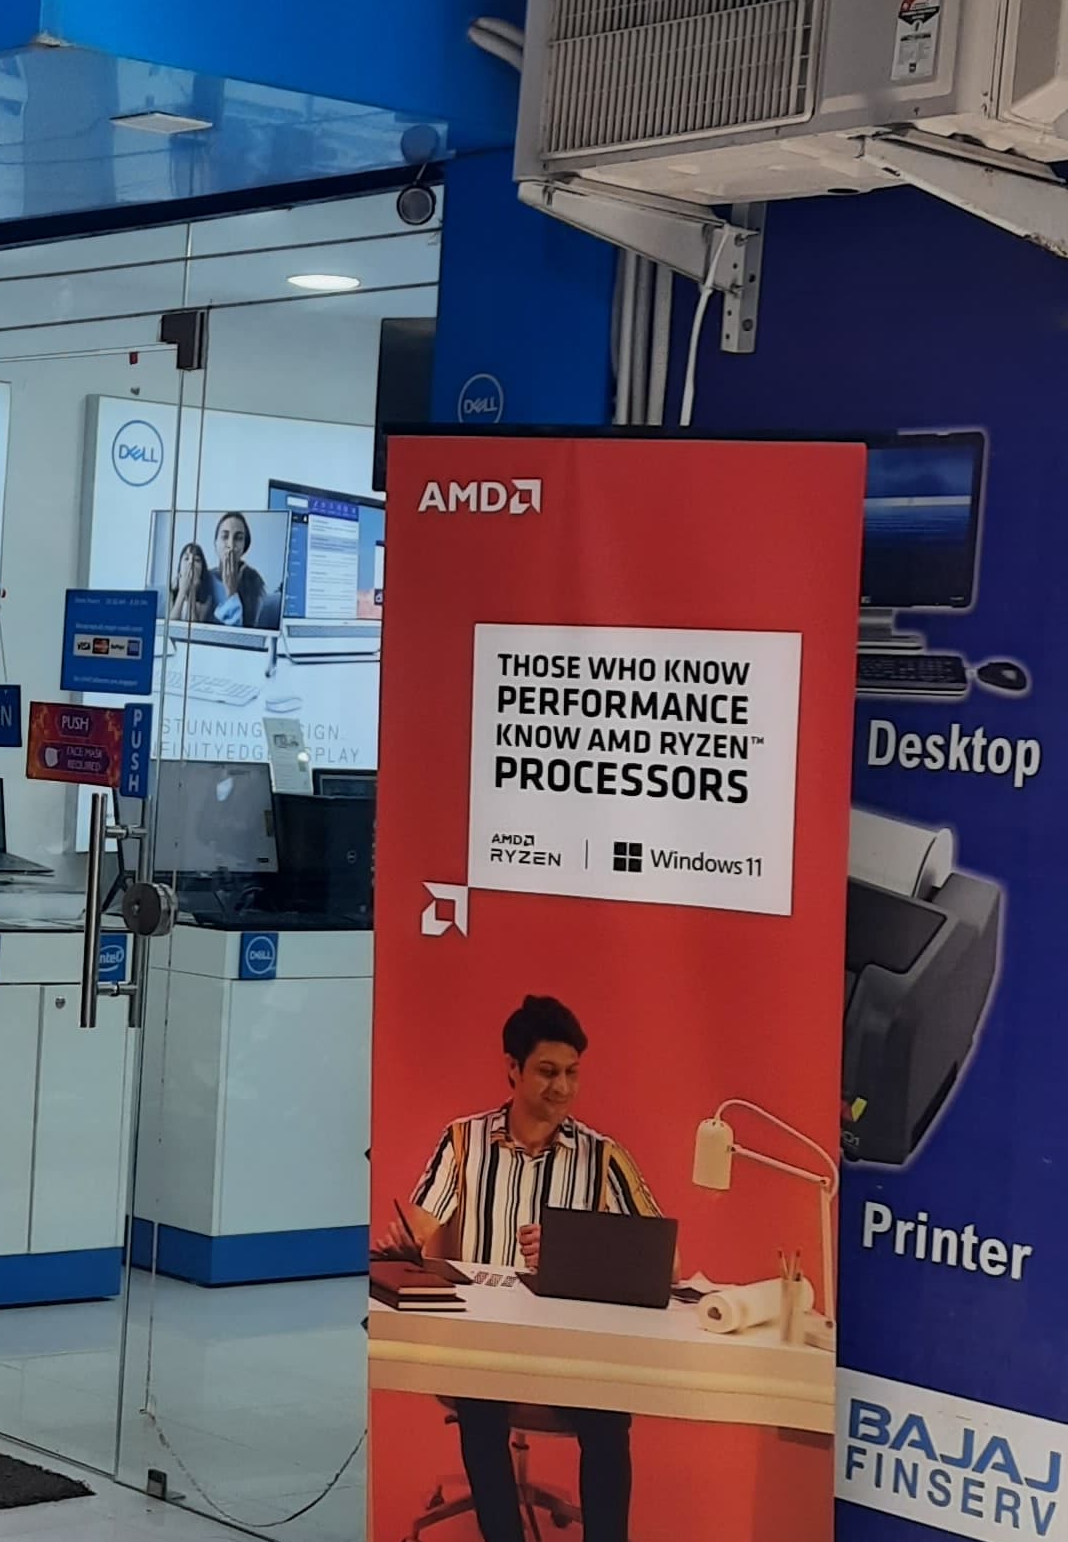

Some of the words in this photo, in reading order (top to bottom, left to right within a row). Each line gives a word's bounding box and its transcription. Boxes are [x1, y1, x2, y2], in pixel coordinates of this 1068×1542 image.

[464, 396, 498, 414] DELL
[119, 444, 158, 463] DELL
[418, 481, 508, 512] AMD
[497, 653, 581, 679] THOSE
[588, 656, 656, 681] WHO
[664, 659, 750, 686] KNOW
[497, 685, 749, 725] PERFORMANCE
[61, 715, 89, 731] PUSH
[162, 717, 263, 737] STUNNING
[496, 723, 581, 750] KNOW
[587, 728, 651, 753] AMD
[128, 709, 142, 793] PUSH
[868, 719, 1041, 787] Desktop
[495, 756, 748, 804] PROCESSORS
[491, 832, 522, 846] AMD
[490, 848, 561, 867] RYZEN
[651, 848, 743, 875] Windows
[99, 950, 123, 964] ntel
[863, 1200, 1033, 1281] Printer
[848, 1397, 1062, 1493] BAJAJ
[845, 1444, 1057, 1537] FINSERV
